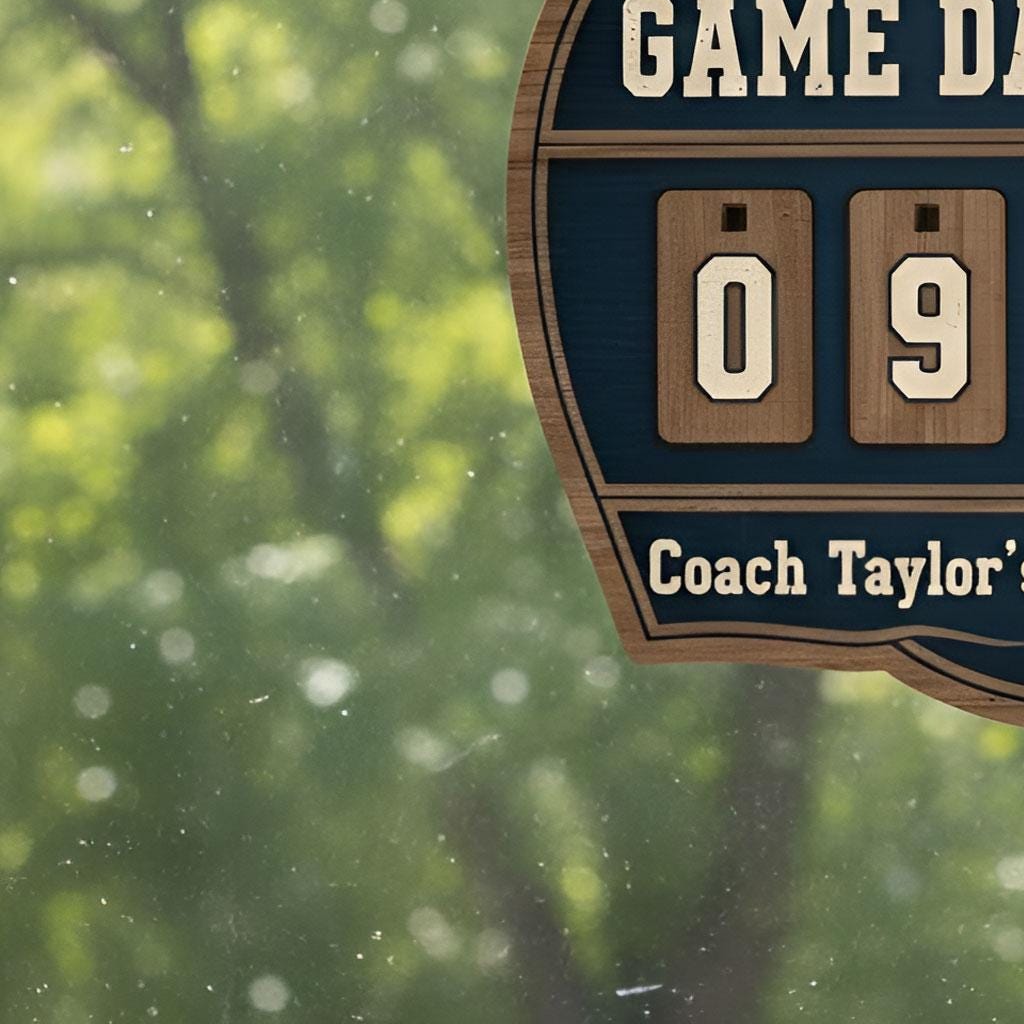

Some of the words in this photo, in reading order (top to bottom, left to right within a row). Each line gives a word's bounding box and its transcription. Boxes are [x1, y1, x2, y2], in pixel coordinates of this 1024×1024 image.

[695, 255, 774, 401] 0
[890, 255, 969, 401] 9
[648, 537, 808, 596] Coach
